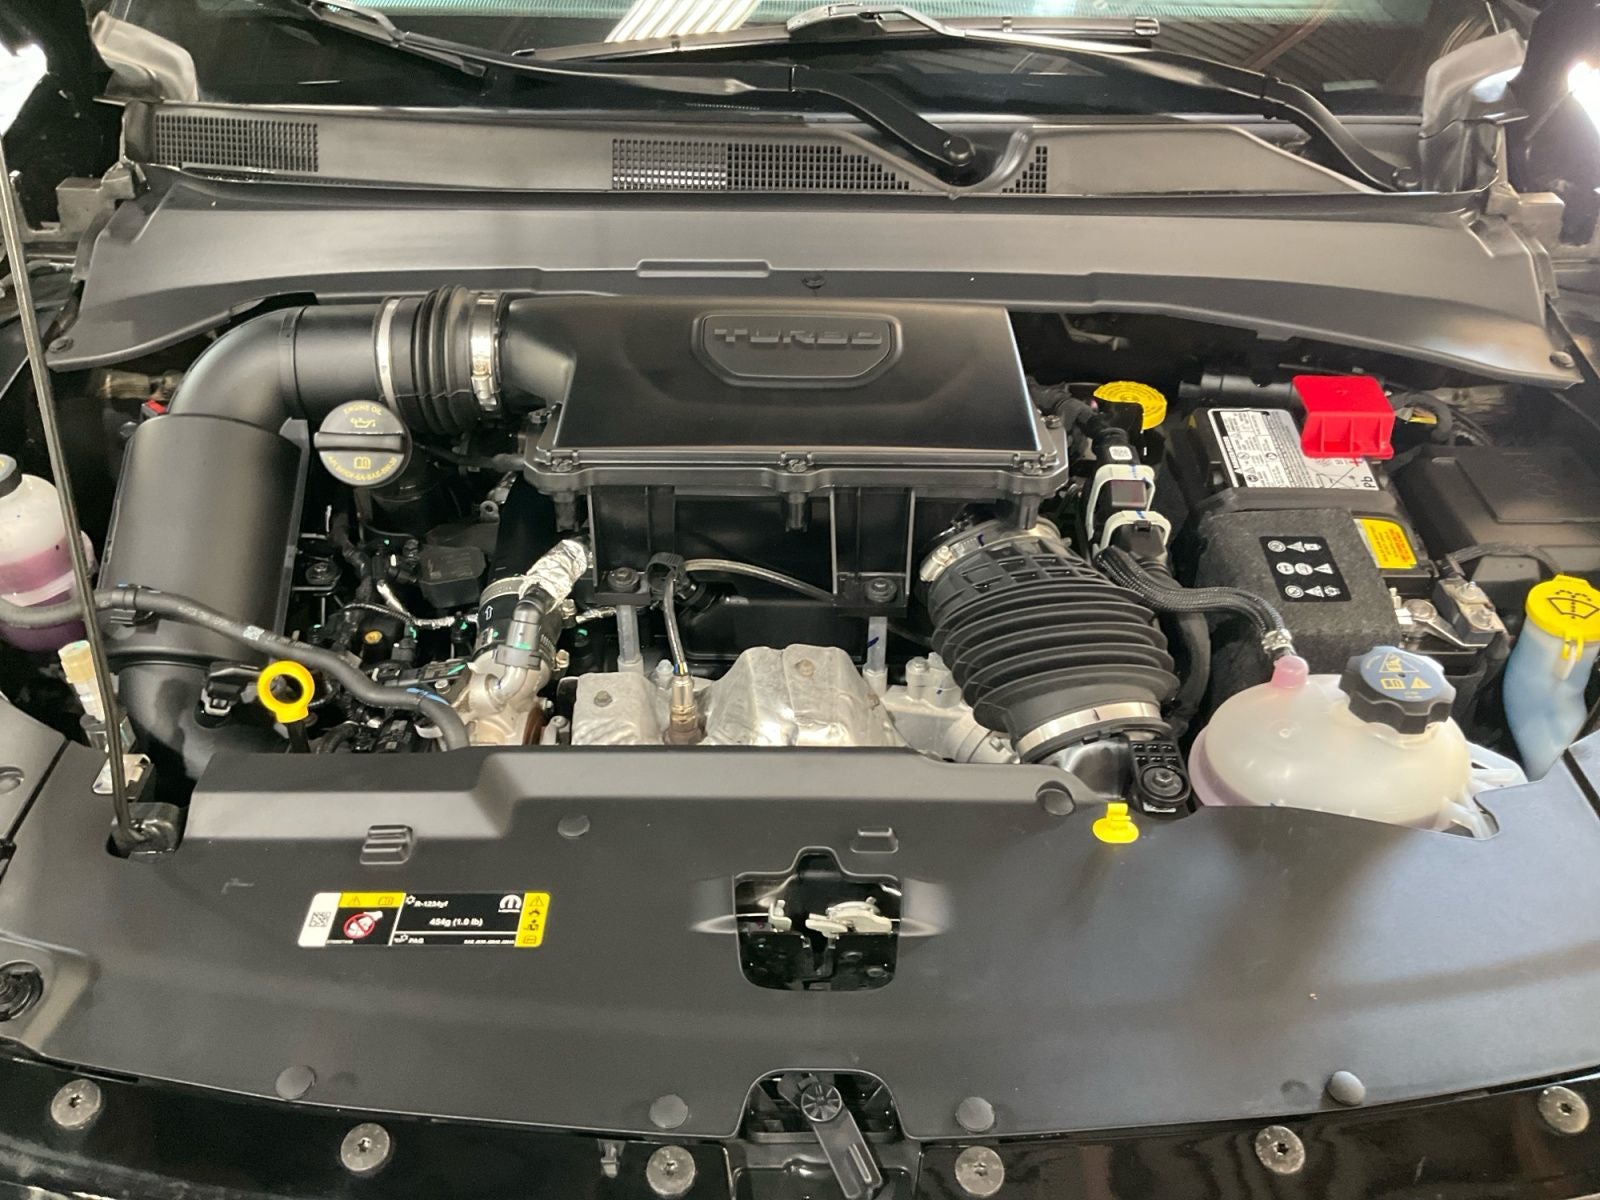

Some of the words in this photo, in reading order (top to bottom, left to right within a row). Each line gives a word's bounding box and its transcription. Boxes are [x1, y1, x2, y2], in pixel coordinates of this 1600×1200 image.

[714, 326, 883, 346] TURBO
[1360, 475, 1377, 488] Pb
[413, 899, 449, 909] R-1234yf
[429, 917, 452, 928] 454g
[470, 917, 484, 927] lb)
